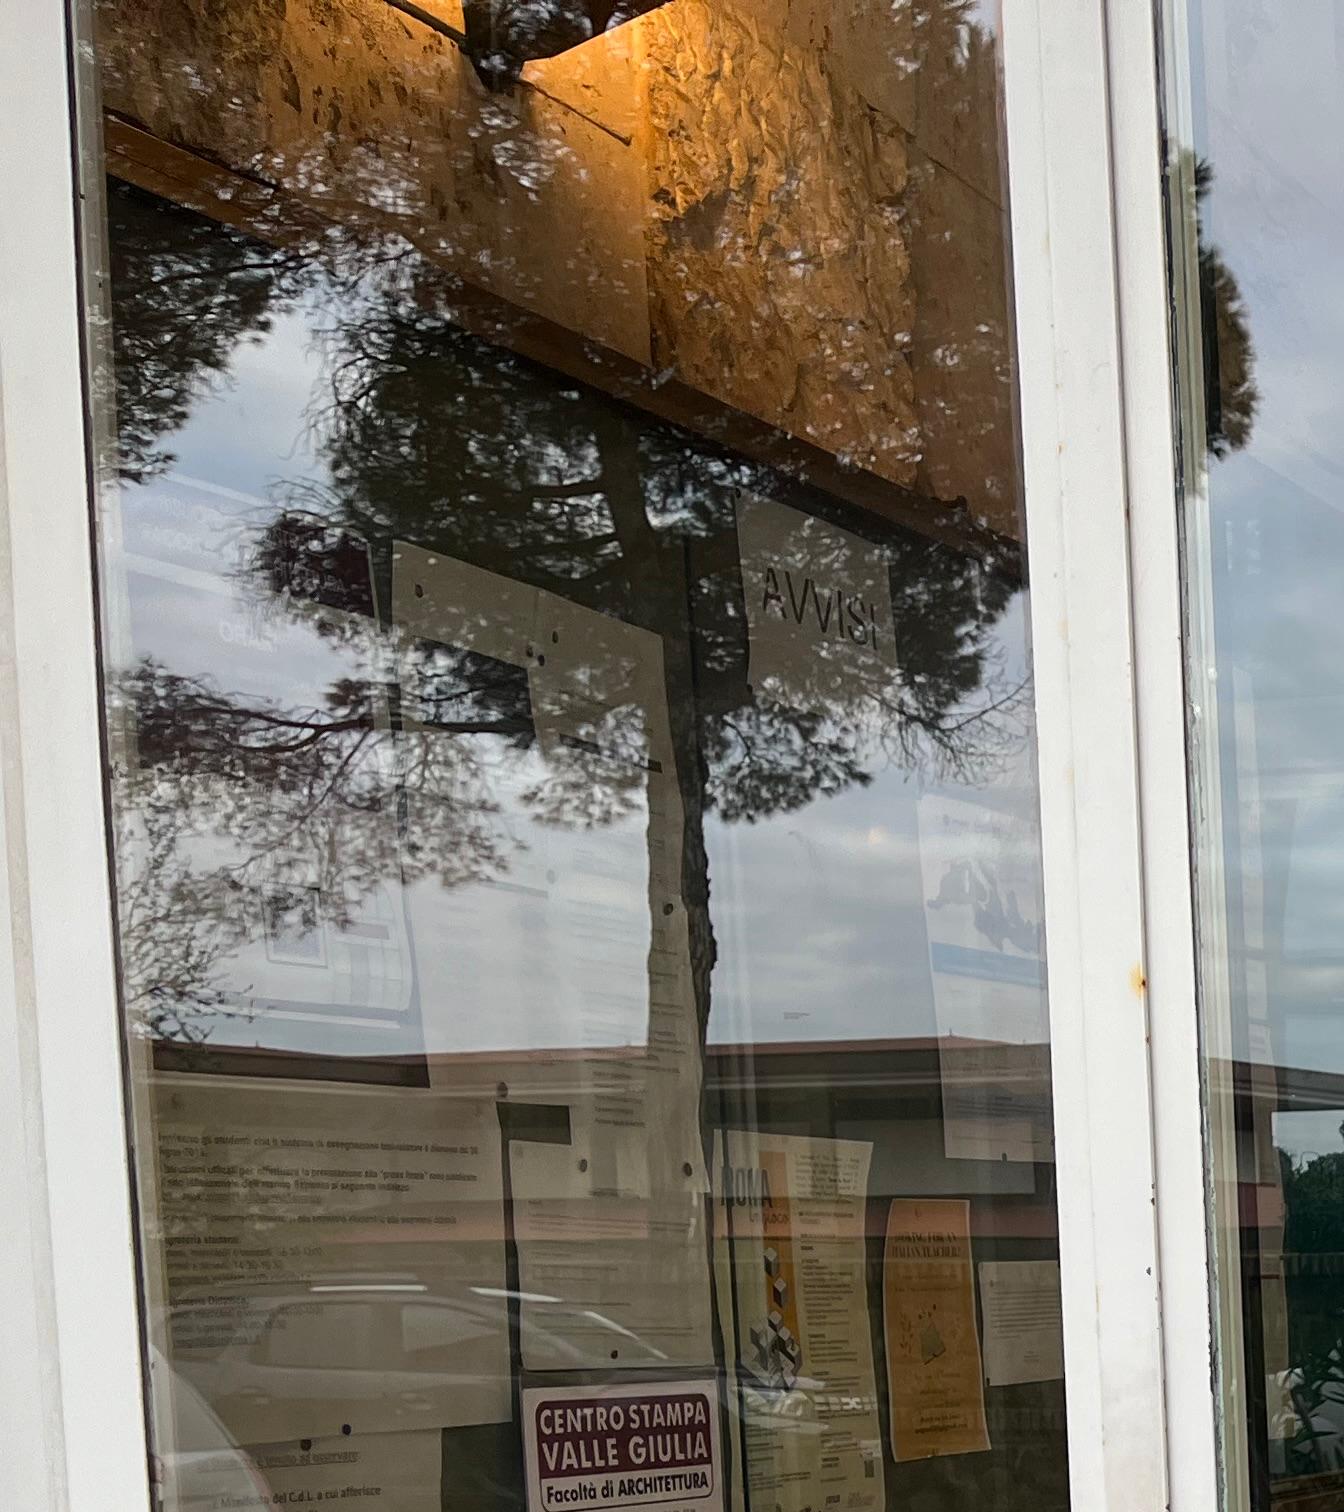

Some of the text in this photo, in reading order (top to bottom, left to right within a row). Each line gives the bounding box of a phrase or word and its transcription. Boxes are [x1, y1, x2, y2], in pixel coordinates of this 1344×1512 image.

[763, 568, 877, 650] AVVISI
[540, 1401, 707, 1435] CENTRO STAMPA
[542, 1437, 619, 1471] VALLE
[628, 1431, 708, 1465] GIULIA
[272, 1492, 287, 1504] del
[546, 1471, 709, 1504] Facoltà di ARCHITETTURA
